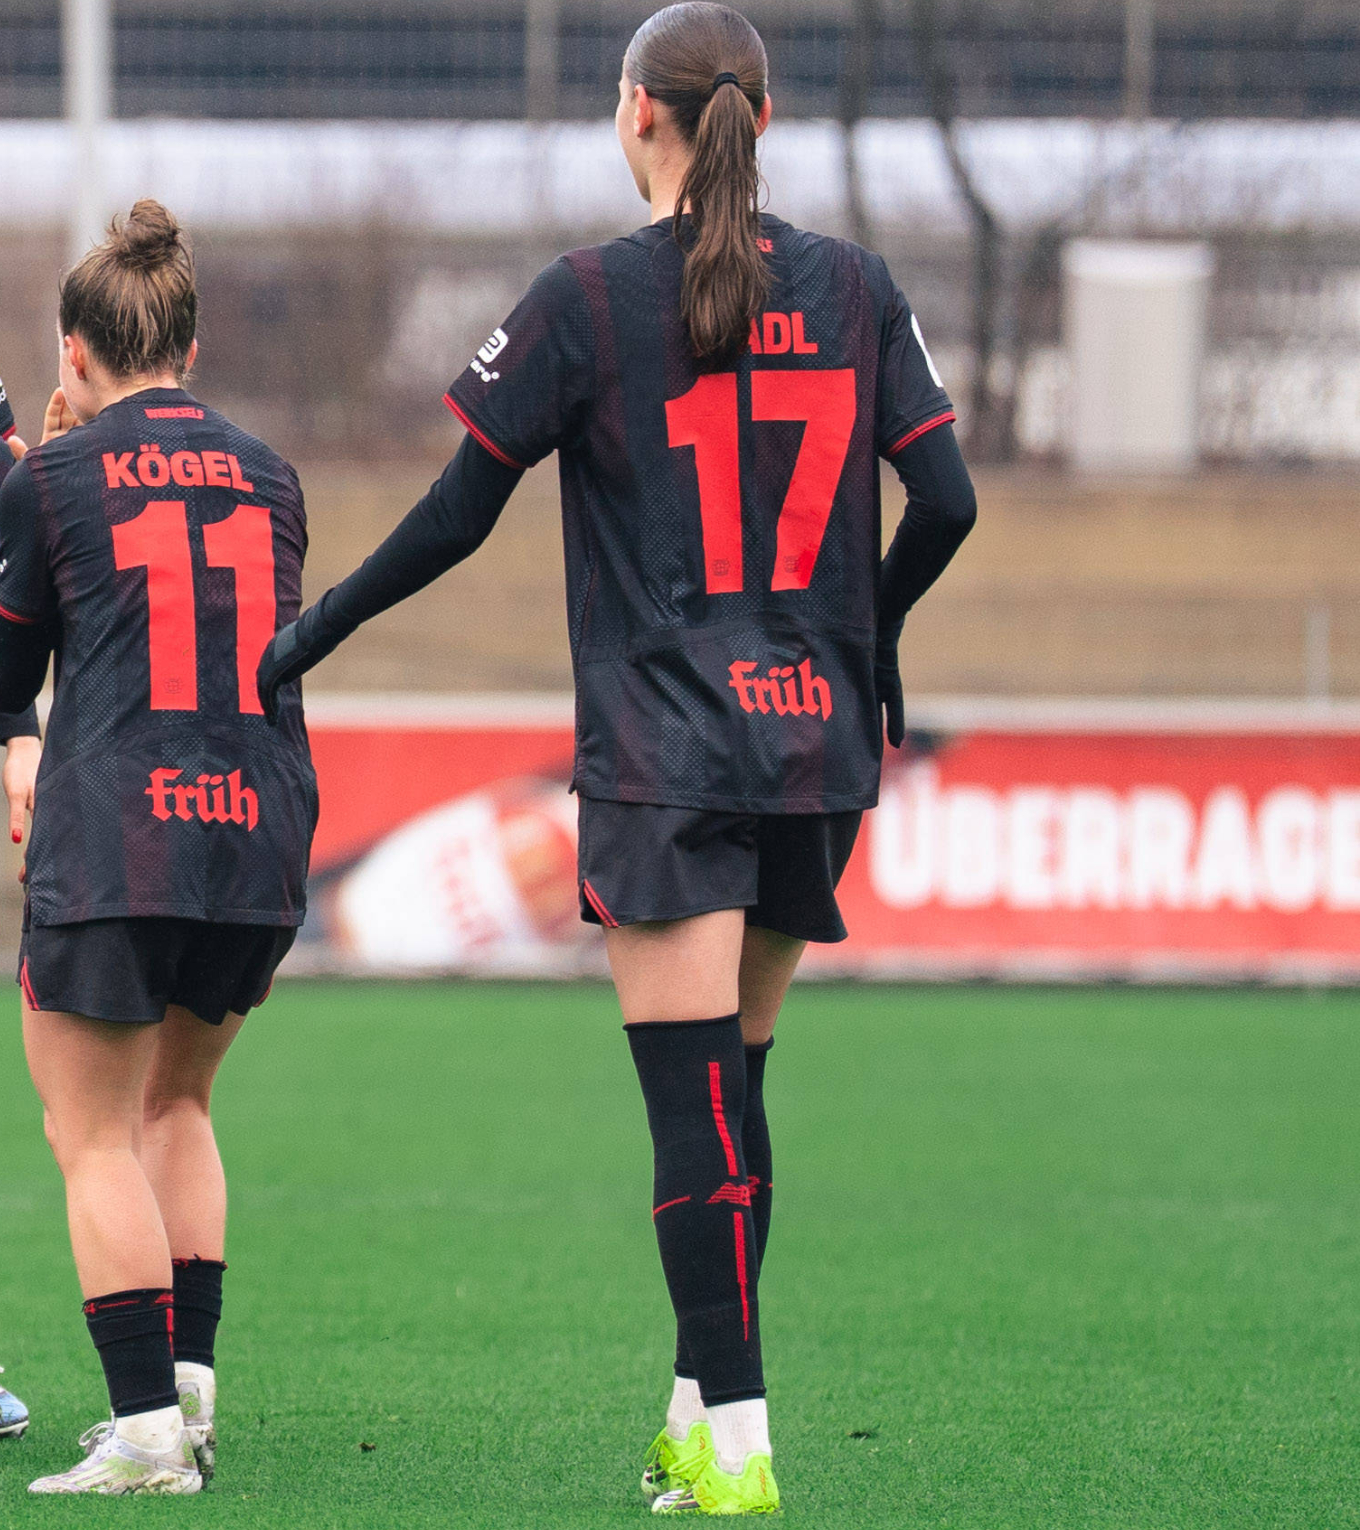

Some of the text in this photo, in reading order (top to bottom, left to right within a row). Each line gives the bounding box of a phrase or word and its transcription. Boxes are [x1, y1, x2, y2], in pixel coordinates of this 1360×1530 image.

[101, 443, 255, 494] KÖGEL
[664, 368, 857, 595] 17
[110, 500, 277, 716] 11
